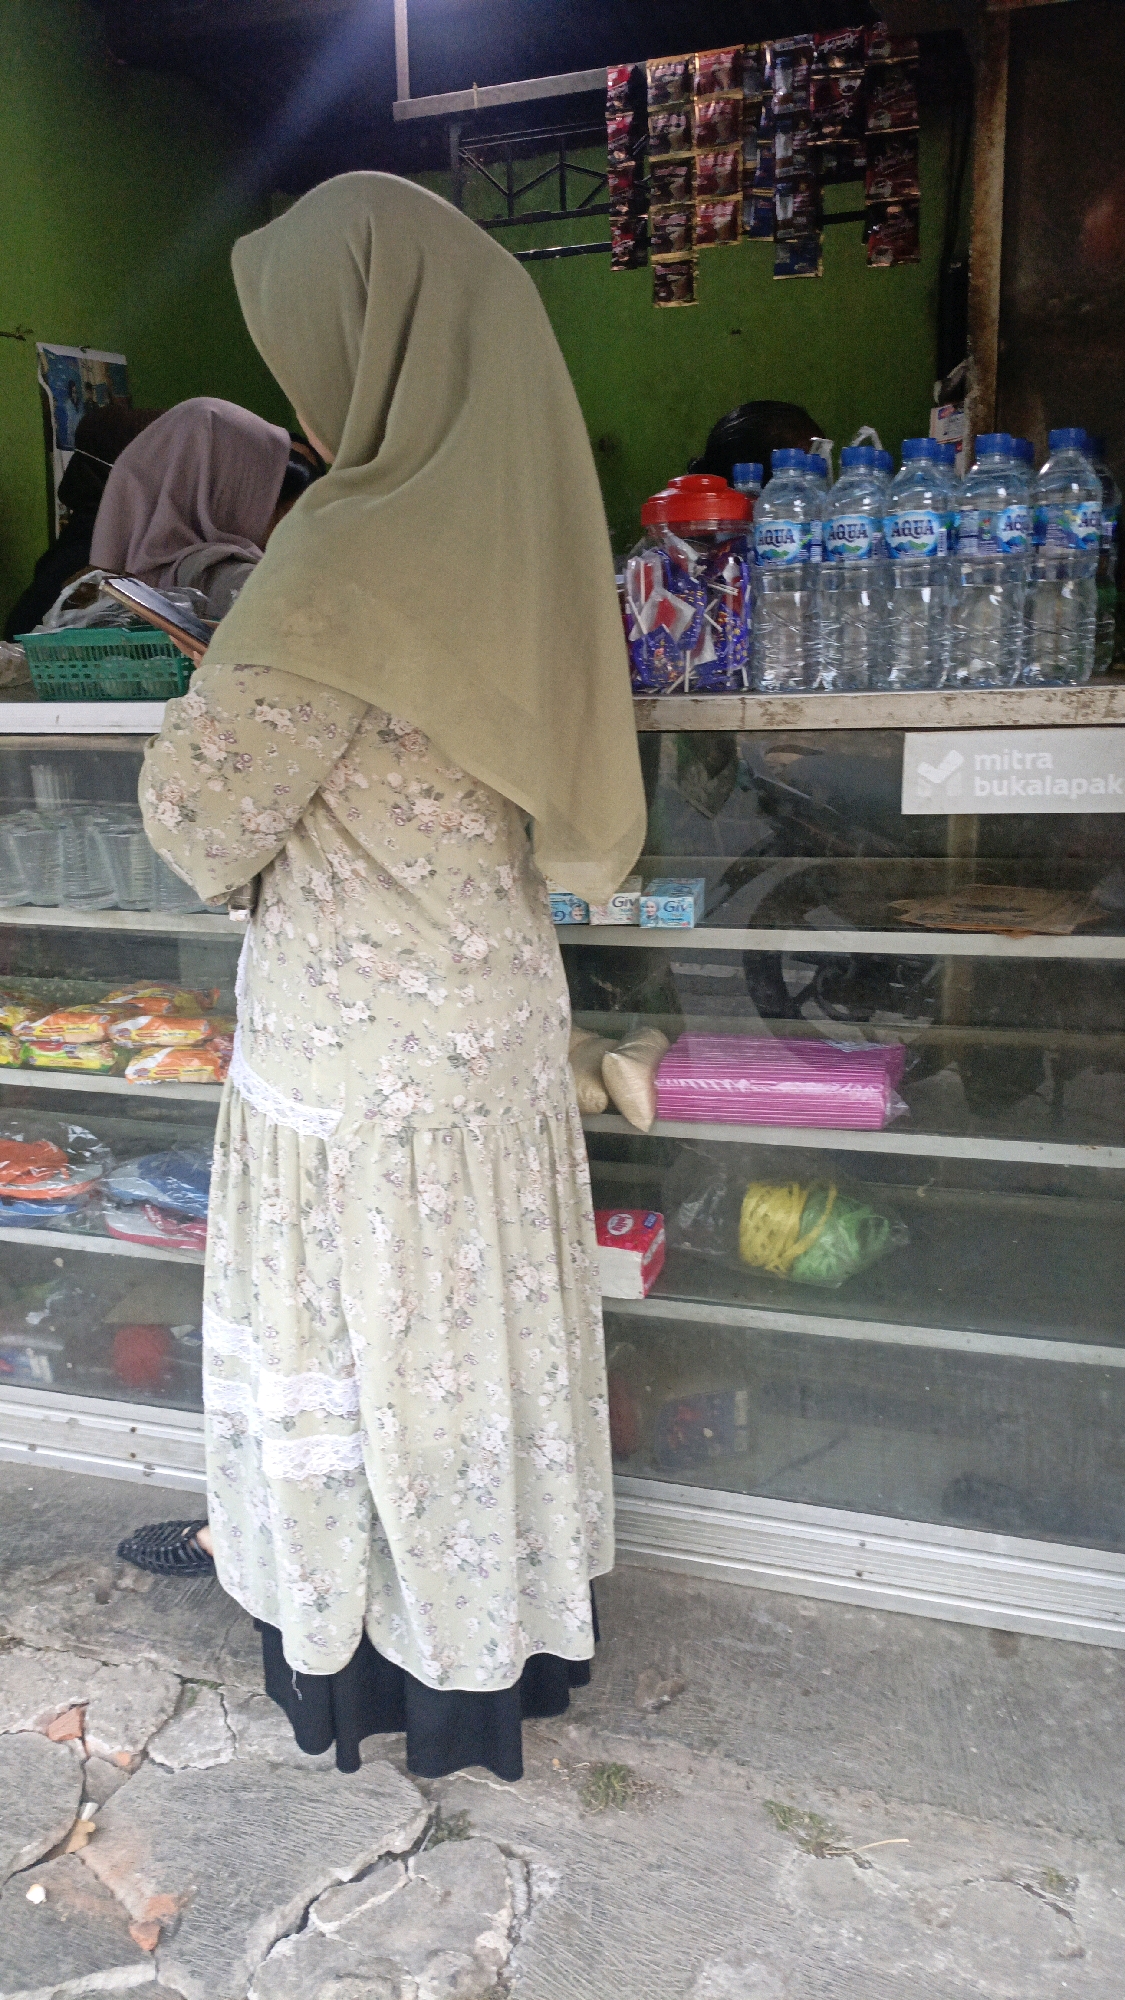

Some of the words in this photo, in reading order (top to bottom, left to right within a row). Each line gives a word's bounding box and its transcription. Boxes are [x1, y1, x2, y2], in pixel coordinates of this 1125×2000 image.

[757, 528, 797, 548] AQUA
[828, 523, 869, 543] AQUA
[891, 519, 935, 540] AQUA
[974, 749, 1054, 771] mitra
[973, 774, 1124, 799] bukalapak
